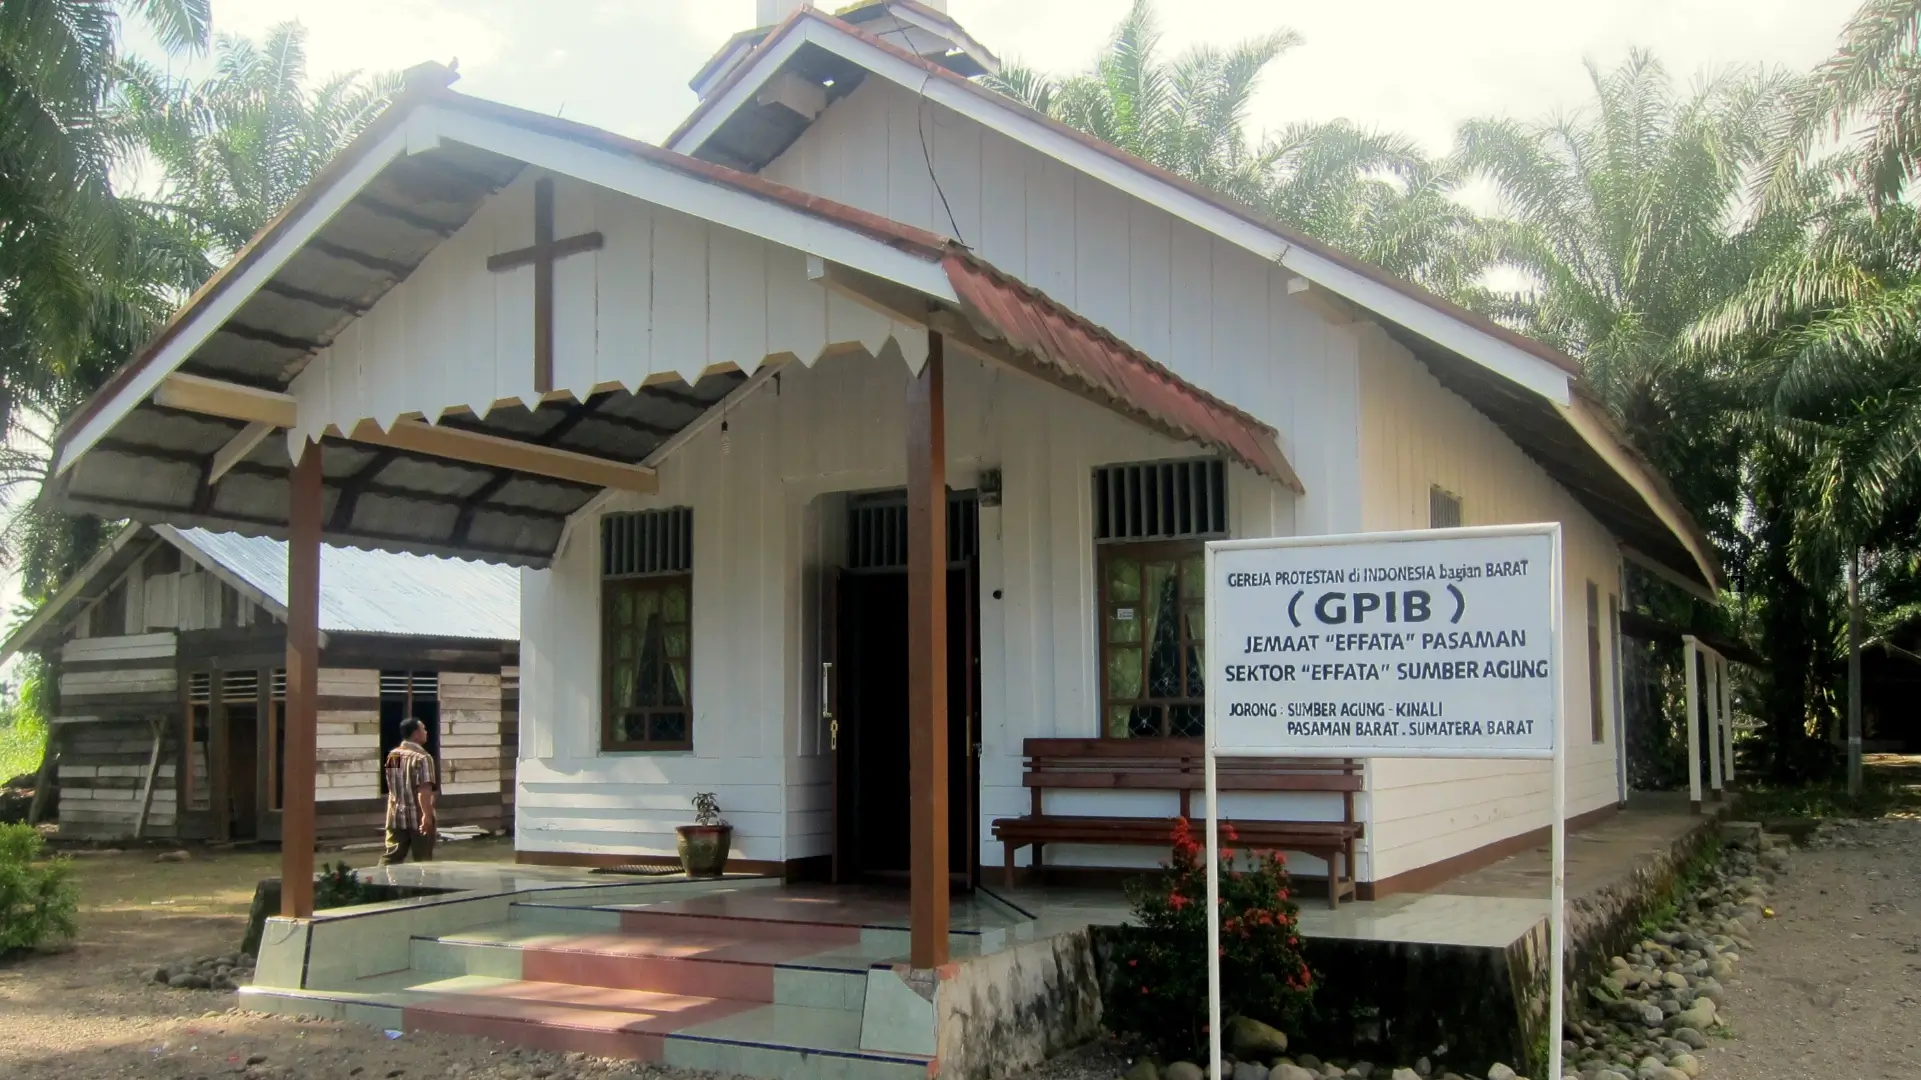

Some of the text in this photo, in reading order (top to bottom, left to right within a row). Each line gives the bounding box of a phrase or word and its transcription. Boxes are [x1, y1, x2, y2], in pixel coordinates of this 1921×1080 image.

[1228, 560, 1528, 587] GEREJA PROTESTAN di INDONESIA bagian BARAT
[1245, 635, 1319, 653] JEMAAT
[1422, 630, 1525, 649] PASAMAN
[1226, 665, 1295, 682] SEKTOR
[1398, 662, 1479, 679] SUMBER
[1483, 660, 1548, 678] AGUNG
[1288, 703, 1336, 717] SUMBER
[1340, 703, 1384, 716] AGUNG
[1397, 703, 1442, 716] KINALI
[1288, 722, 1350, 736] PASAMAN
[1410, 721, 1482, 735] SUMATERA
[1488, 720, 1533, 734] BARAT
